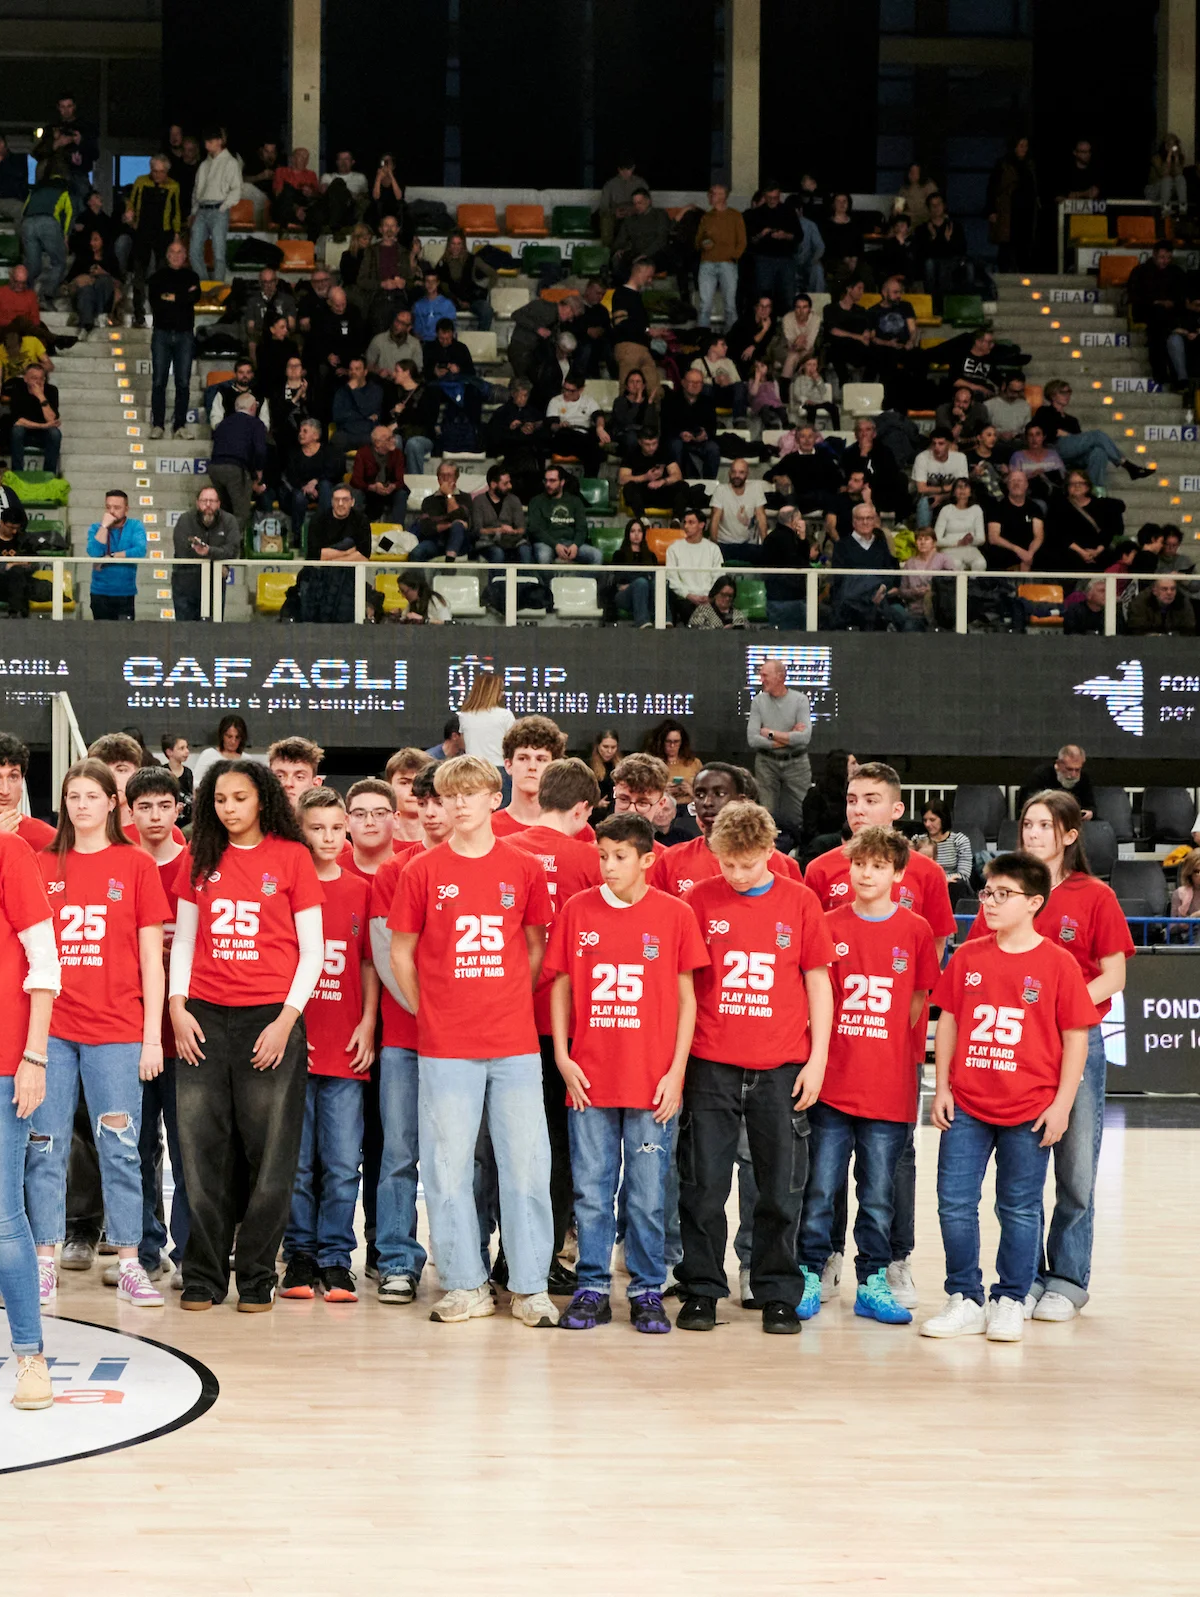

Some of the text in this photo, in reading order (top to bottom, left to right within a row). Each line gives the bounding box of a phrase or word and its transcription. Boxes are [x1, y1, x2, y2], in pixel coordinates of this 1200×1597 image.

[1054, 290, 1096, 302] FILA 9
[1084, 334, 1128, 346] FILA 8
[1116, 379, 1144, 391] FILA
[1148, 427, 1194, 440] FILA 6
[159, 460, 207, 473] FILA 5
[122, 656, 408, 690] CAF ACLI
[503, 667, 568, 688] FIP
[127, 691, 180, 708] dove
[187, 692, 241, 709] tutto
[308, 694, 405, 715] semplice
[505, 691, 695, 715] TRENTINO ALTO ADIGE
[1160, 706, 1195, 722] per
[437, 884, 459, 899] 30
[59, 905, 108, 941] 25
[210, 898, 261, 937] 25
[455, 915, 505, 953] 25
[708, 919, 730, 935] 30
[212, 938, 255, 949] PLAY HARD
[579, 931, 599, 946] 30
[61, 944, 101, 955] PLAY HARD
[236, 949, 259, 961] HARD
[60, 956, 103, 967] STUDY HARD
[455, 955, 502, 966] PLAY HARD
[454, 966, 505, 978] STUDY HARD
[721, 950, 776, 991] 25
[320, 978, 340, 990] HARD
[591, 963, 644, 1002] 25
[321, 990, 342, 1001] HARD
[721, 992, 769, 1005] PLAY HARD
[842, 974, 894, 1013] 25
[591, 1005, 637, 1016] PLAY HARD
[718, 1003, 773, 1017] STUDY HARD
[589, 1017, 641, 1029] STUDY HARD
[840, 1013, 886, 1027] PLAY HARD
[969, 1004, 1025, 1046] 25
[837, 1025, 888, 1039] STUDY HARD
[1144, 1033, 1184, 1053] per
[968, 1045, 1014, 1060] PLAY HARD
[965, 1057, 1017, 1072] STUDY HARD
